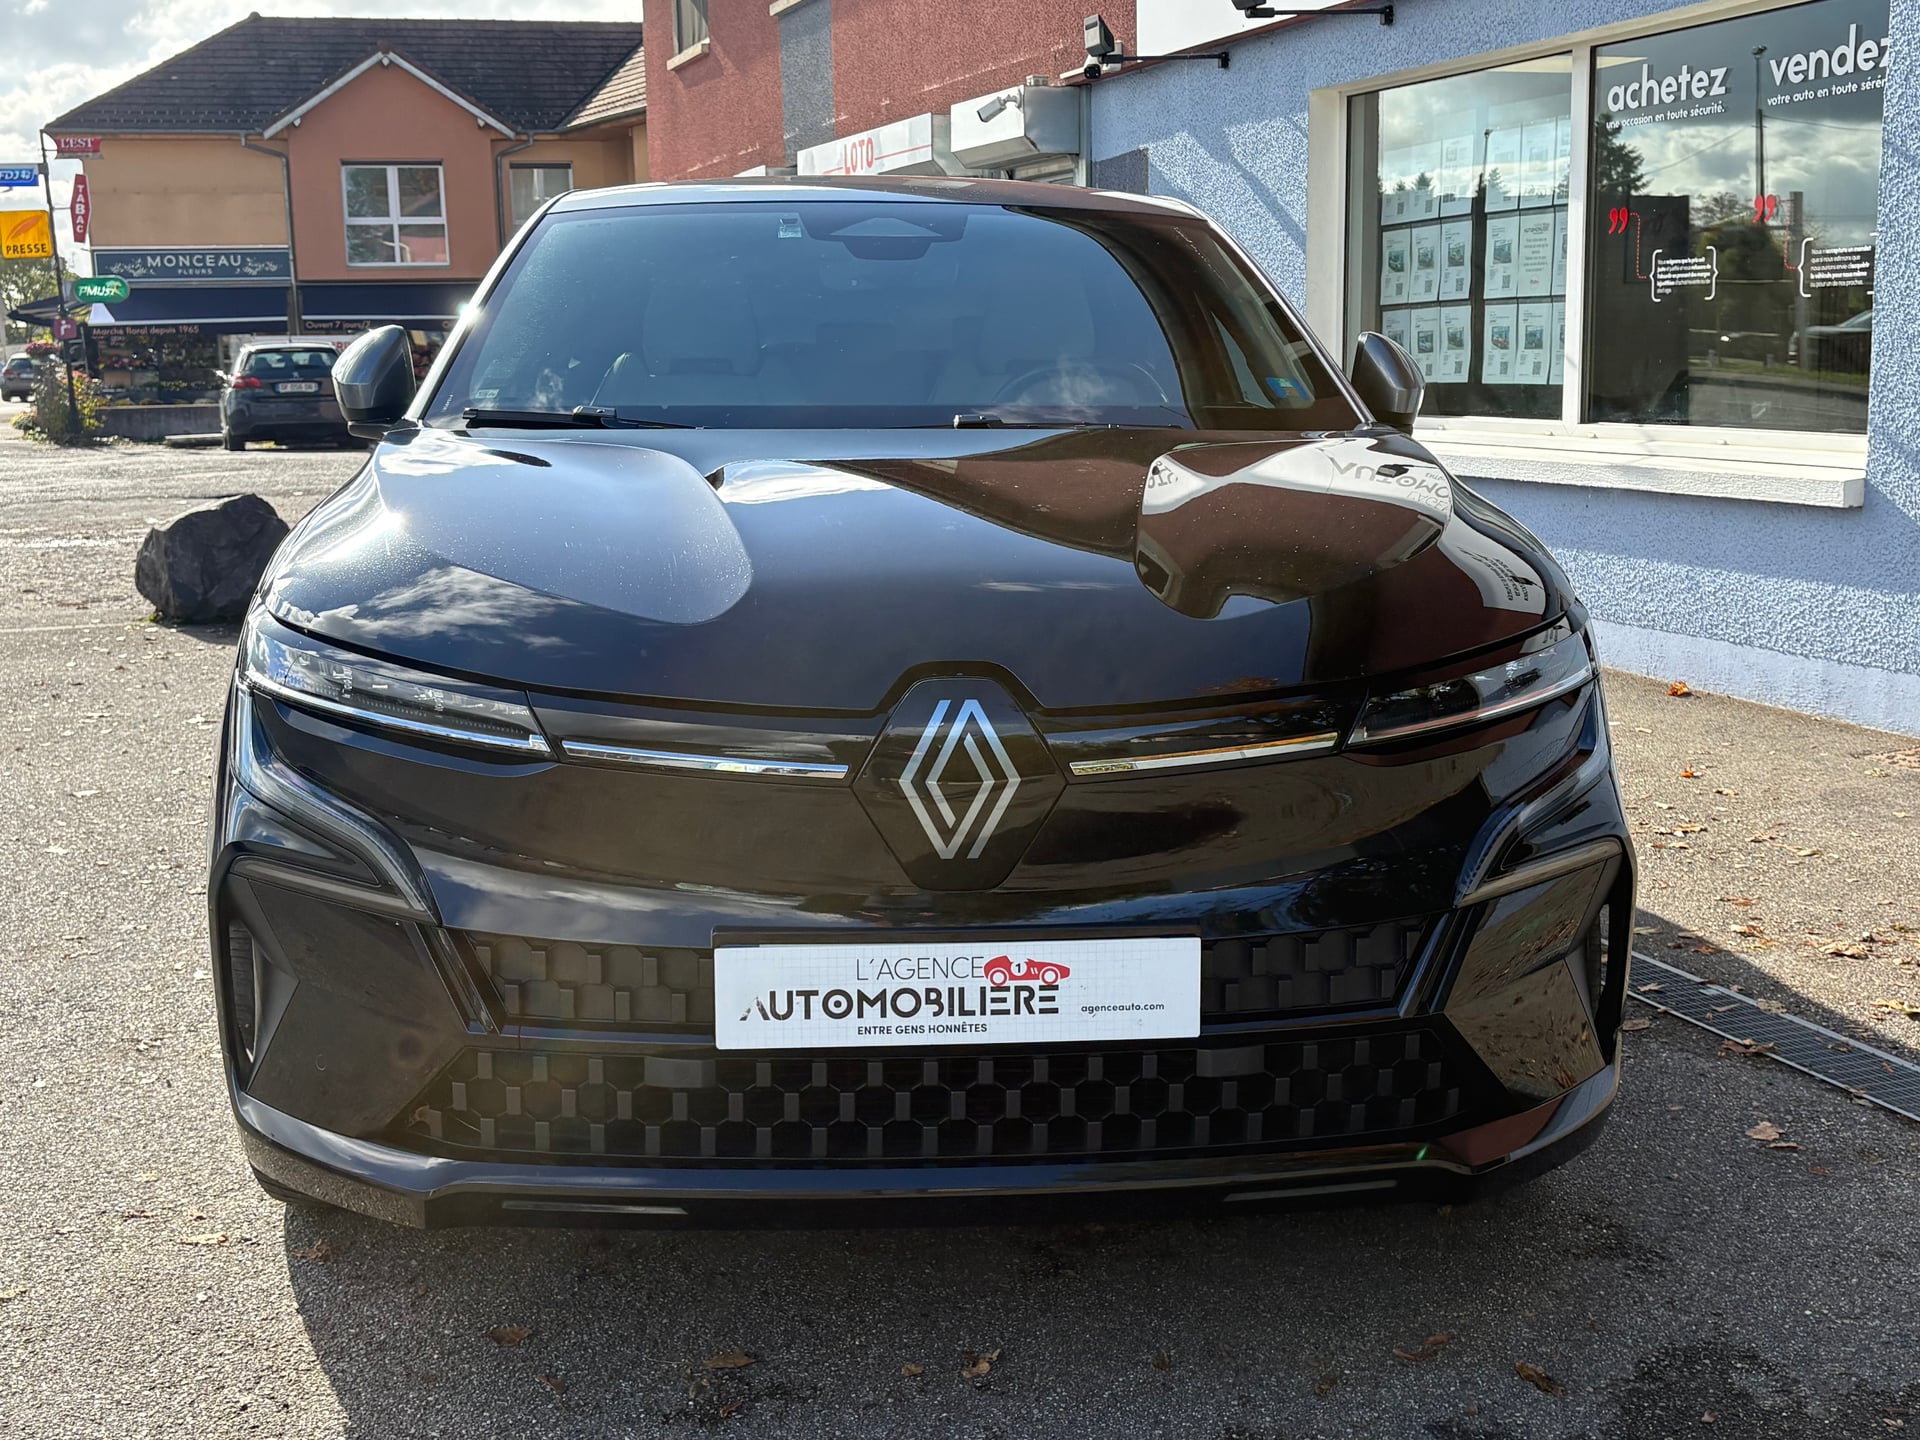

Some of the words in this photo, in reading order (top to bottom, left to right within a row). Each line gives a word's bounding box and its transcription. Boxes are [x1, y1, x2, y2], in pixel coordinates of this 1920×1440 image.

[1607, 63, 1728, 112] achetez
[1767, 93, 1791, 106] votre
[1793, 89, 1815, 102] auto
[1817, 88, 1829, 98] en
[1831, 81, 1858, 95] toute
[1605, 120, 1620, 130] une
[1621, 113, 1654, 128] occasion
[1655, 113, 1665, 122] en
[1666, 109, 1689, 121] toute
[1690, 100, 1726, 117] sécurité.
[61, 137, 94, 149] L'EST
[844, 137, 874, 176] LOTO
[0, 170, 20, 180] FDJ
[75, 185, 86, 233] TABAC
[6, 243, 48, 254] PRESSE
[147, 255, 242, 267] MONCEAU
[93, 327, 124, 336] Marché
[126, 326, 148, 335] floral
[149, 326, 176, 336] depuis
[178, 325, 200, 334] 1965
[305, 320, 334, 329] Ouvert
[856, 956, 985, 980] L'AGENCE
[1015, 963, 1021, 973] 1
[1081, 1002, 1165, 1015] agenceauto.com
[857, 1025, 892, 1035] ENTRE
[895, 1024, 925, 1035] GENS
[928, 1021, 988, 1034] HONNÊTES
